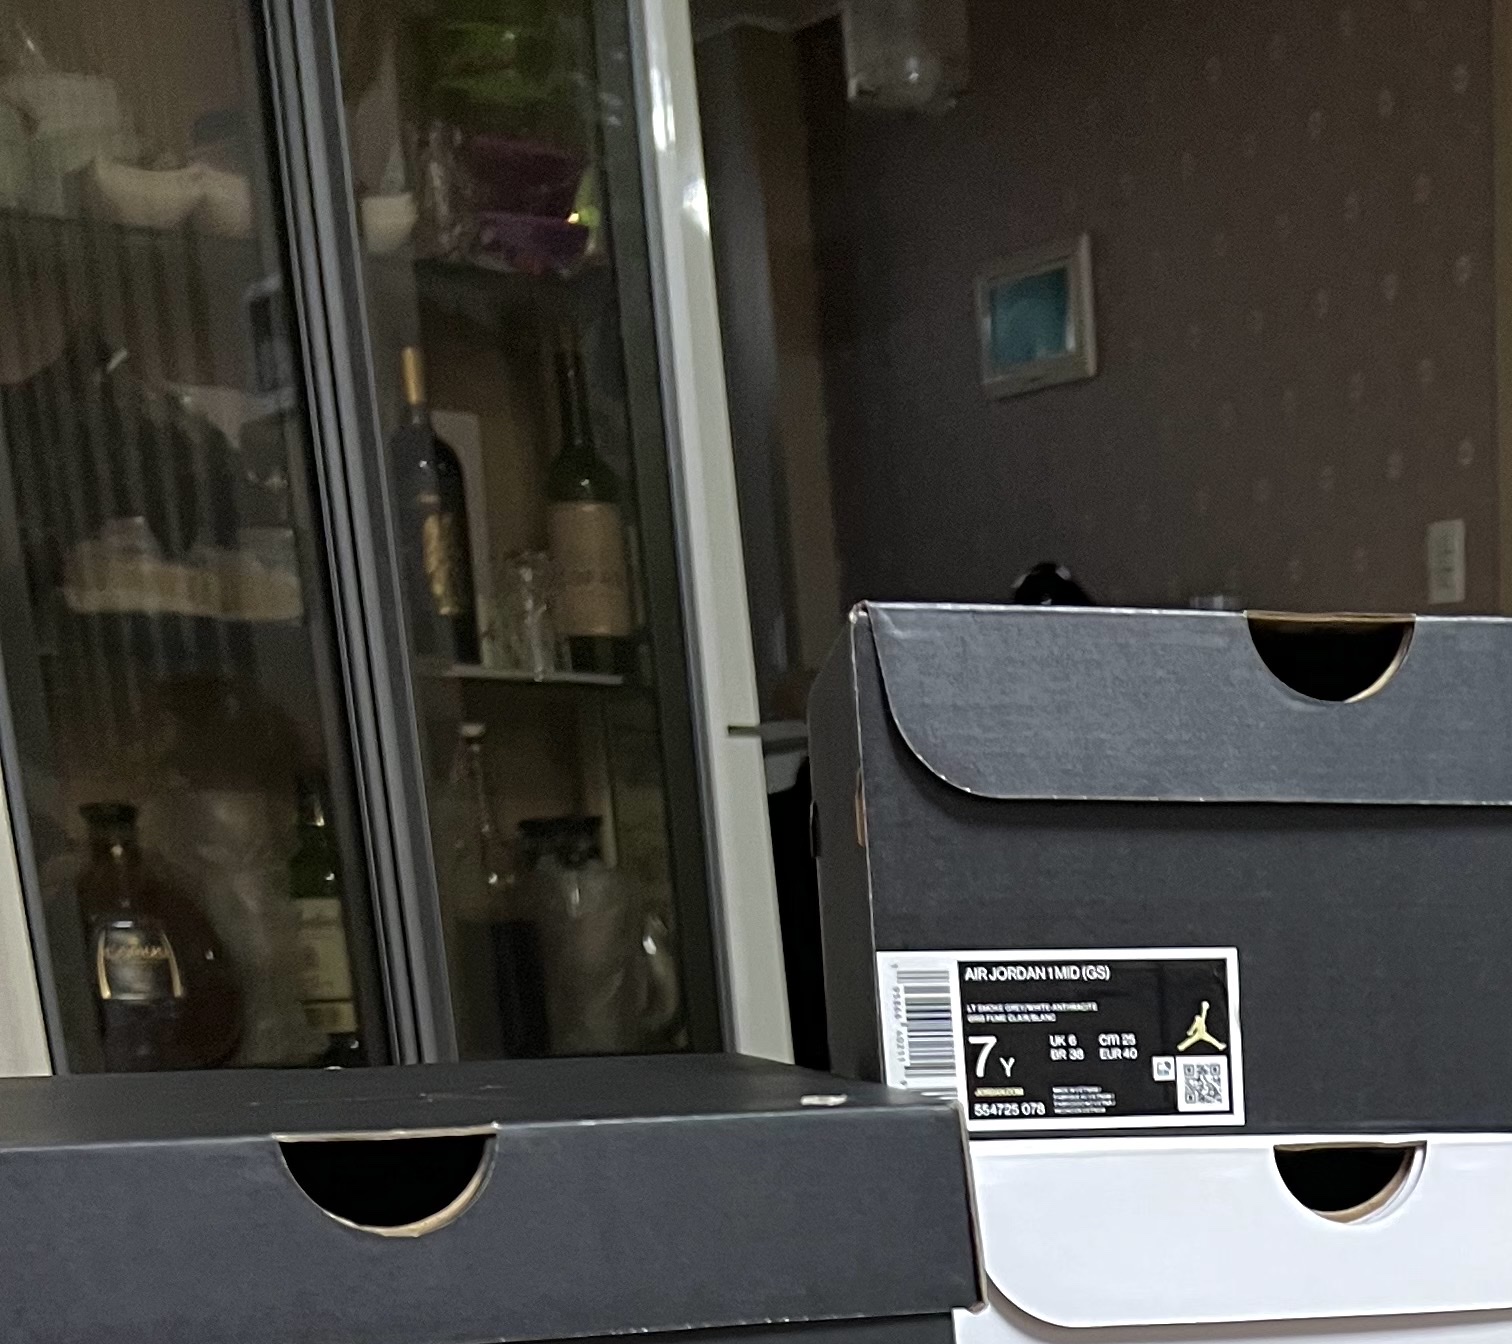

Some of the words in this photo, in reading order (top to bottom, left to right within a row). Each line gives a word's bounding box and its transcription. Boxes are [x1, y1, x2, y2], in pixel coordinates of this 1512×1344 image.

[964, 966, 988, 981] AIR
[988, 965, 1047, 981] JORDAN
[1048, 965, 1054, 980] 1
[1056, 965, 1081, 980] MID
[1082, 964, 1111, 982] (GS)
[1049, 1034, 1067, 1048] UK
[1099, 1047, 1122, 1061] EUR
[1122, 1047, 1138, 1060] 40
[974, 1102, 1020, 1117] 554725
